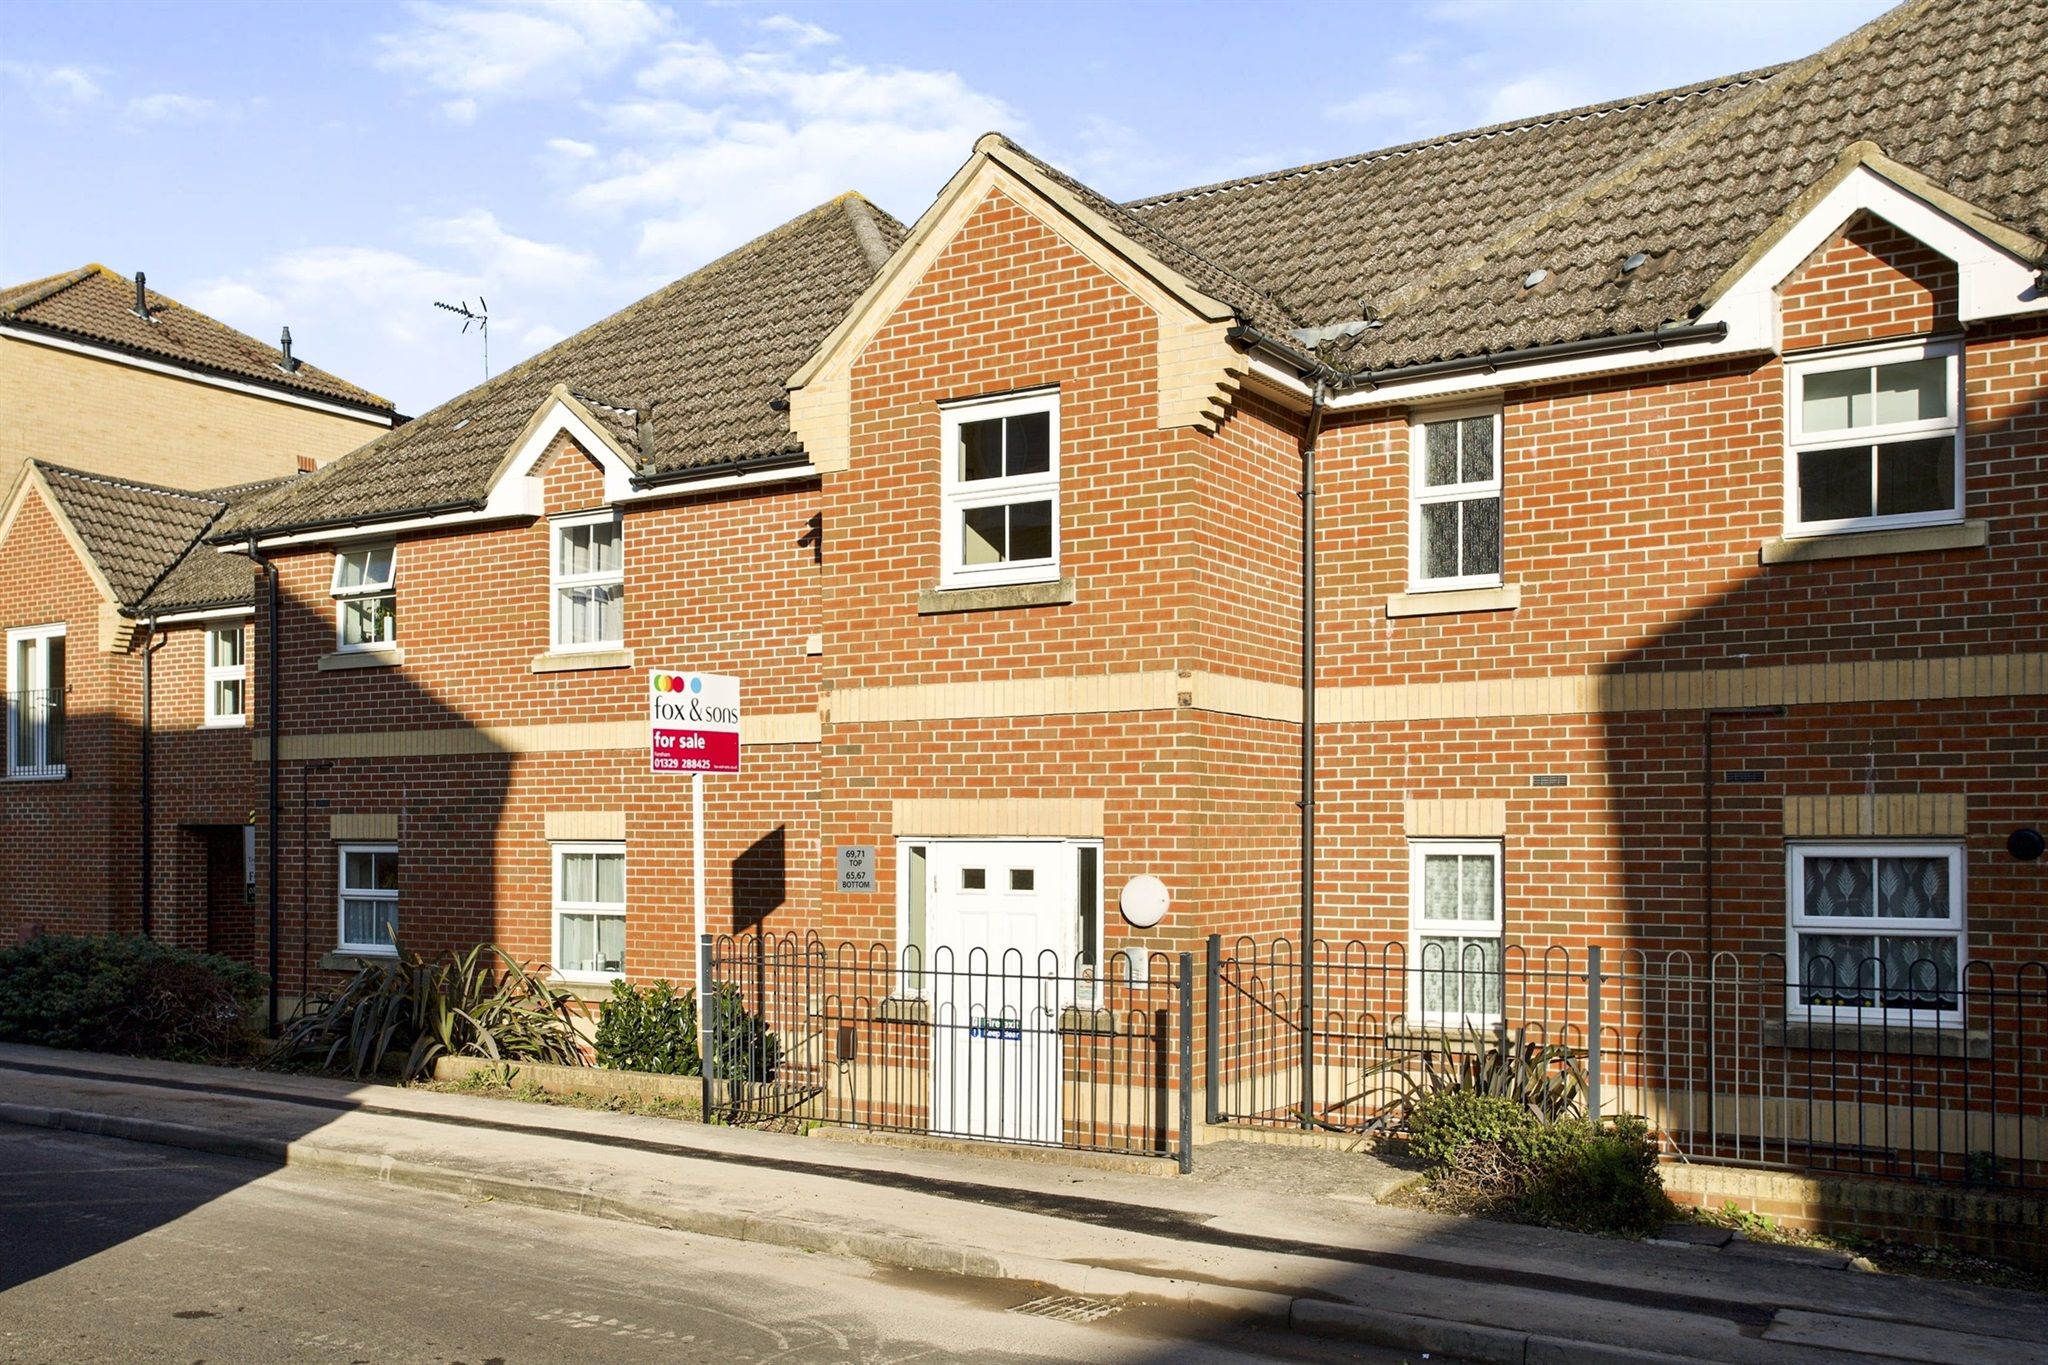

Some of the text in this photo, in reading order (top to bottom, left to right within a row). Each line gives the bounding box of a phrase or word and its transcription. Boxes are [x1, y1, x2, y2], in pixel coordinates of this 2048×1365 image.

[654, 695, 739, 724] fox & sons
[654, 731, 706, 749] for sale
[654, 758, 679, 769] 01329
[681, 758, 711, 770] 288425
[845, 850, 865, 858] 69,71
[845, 871, 866, 880] 65,67
